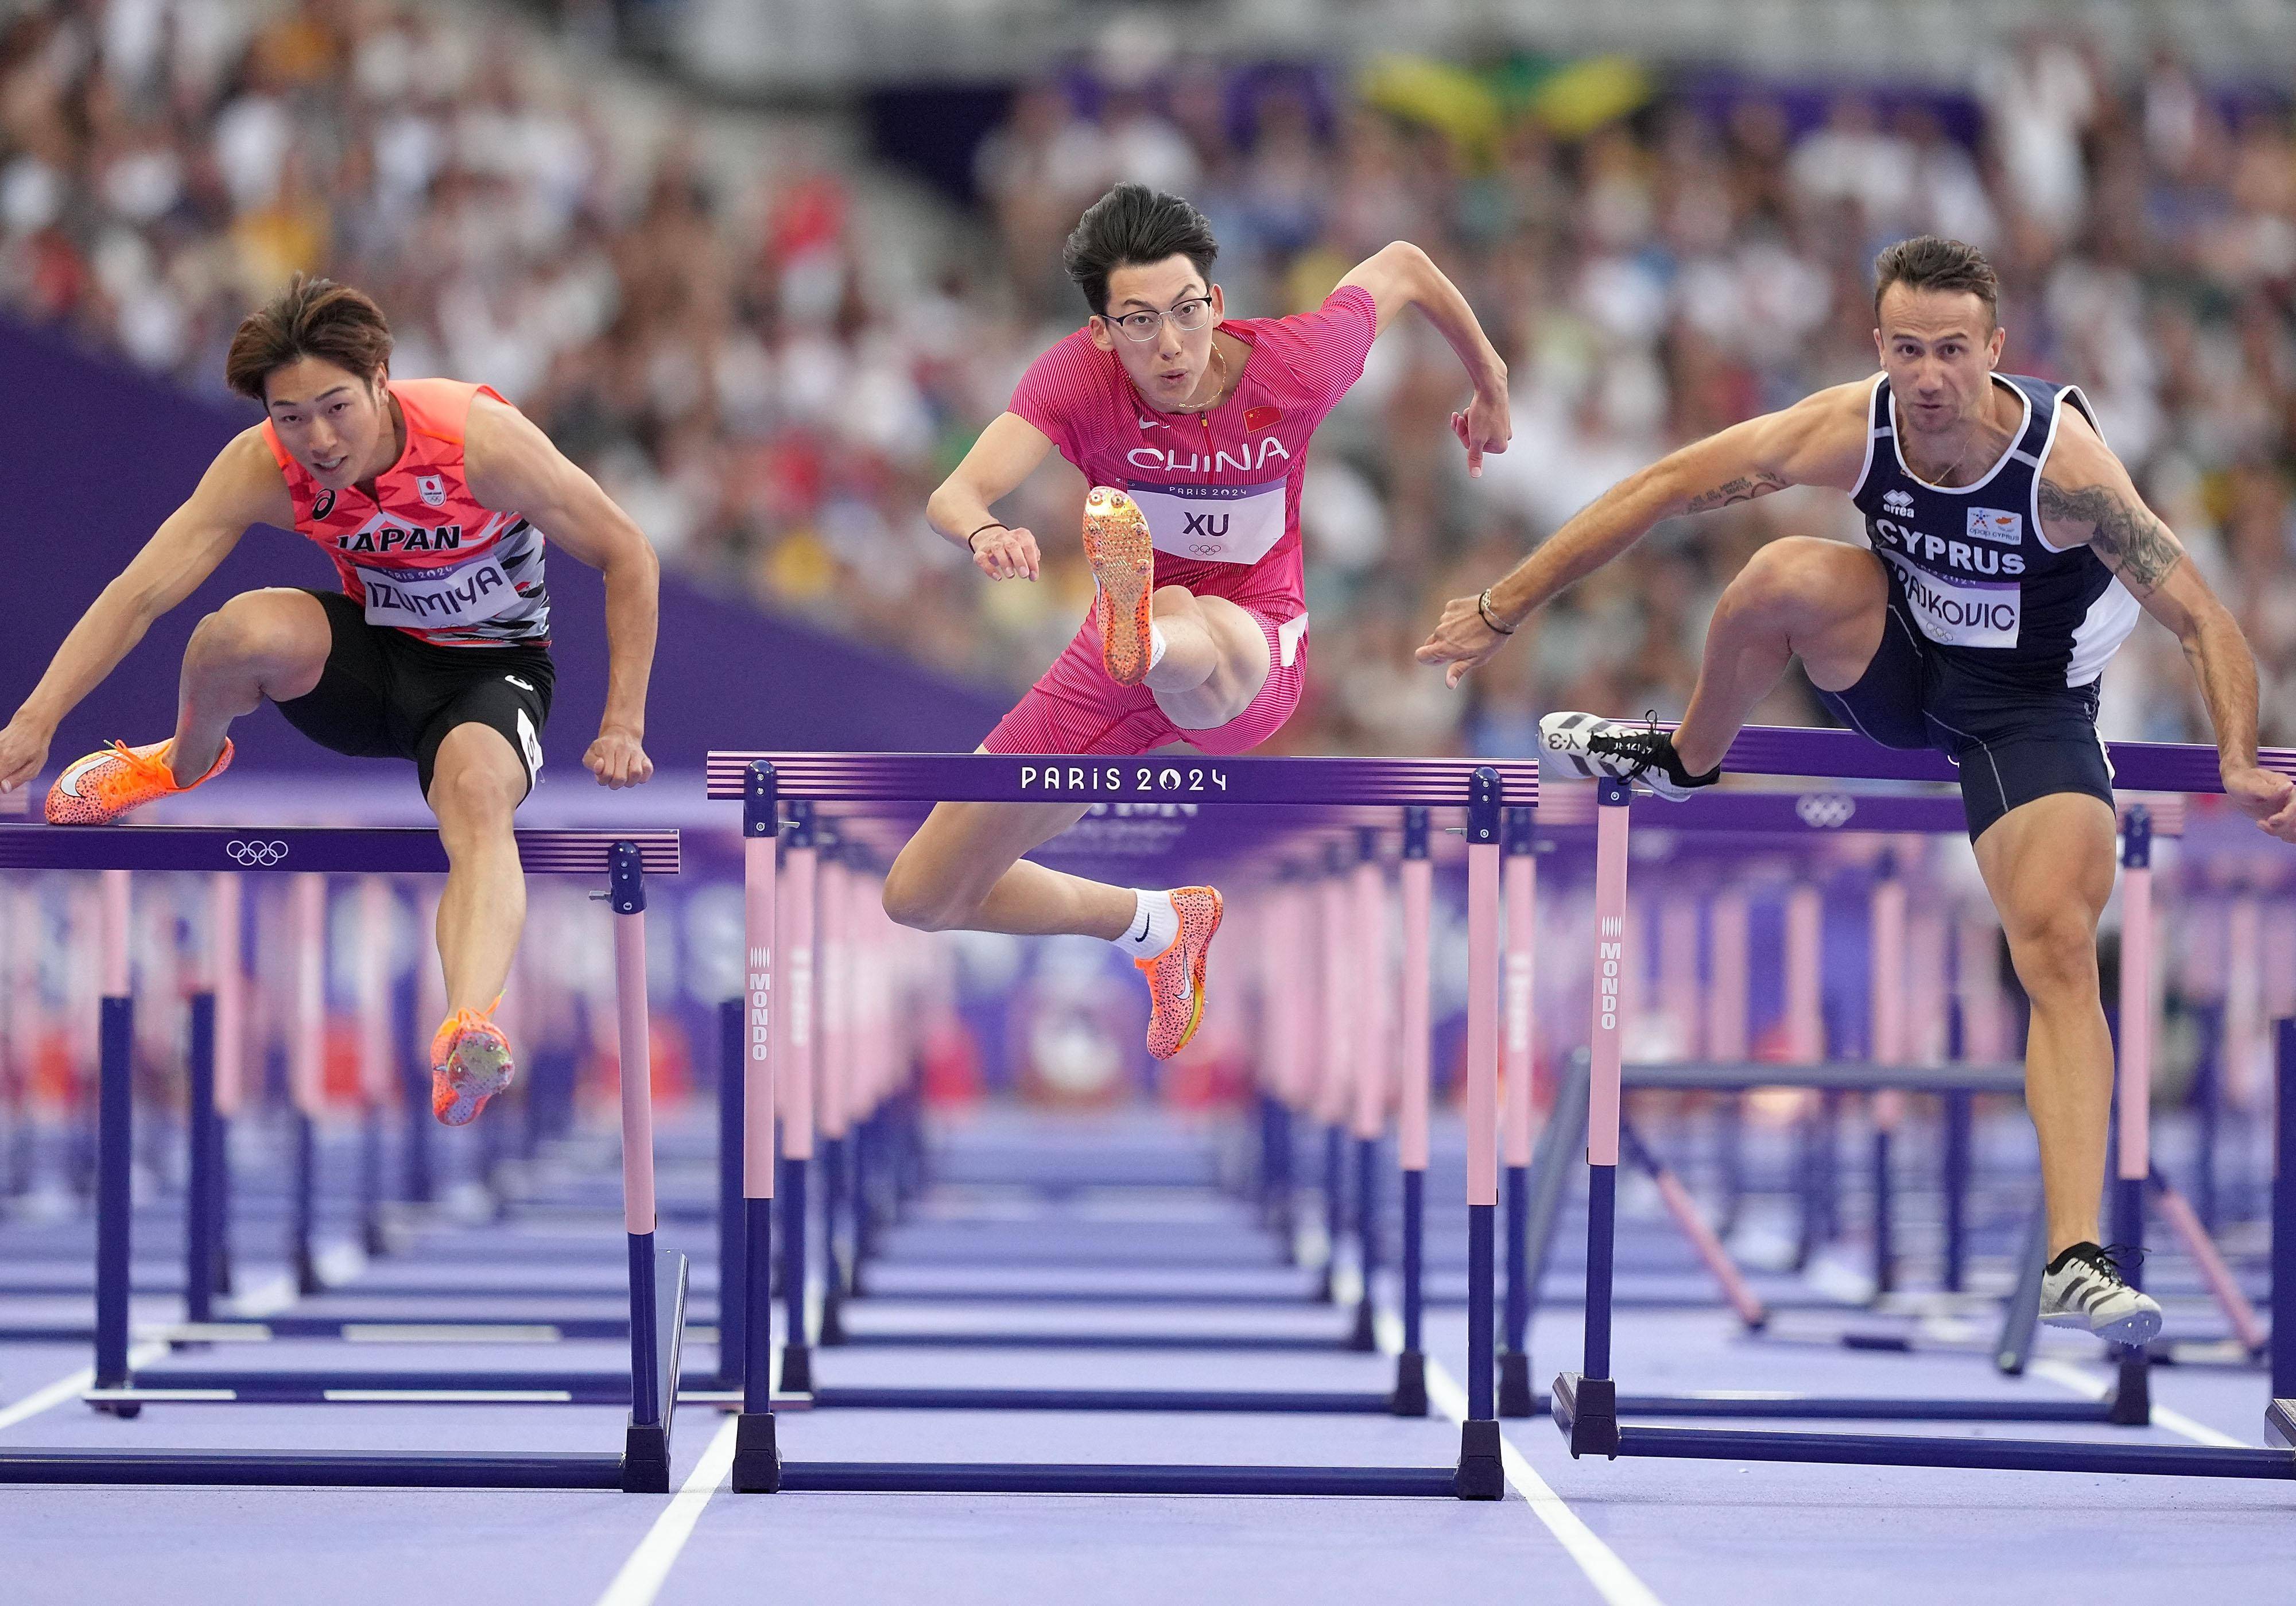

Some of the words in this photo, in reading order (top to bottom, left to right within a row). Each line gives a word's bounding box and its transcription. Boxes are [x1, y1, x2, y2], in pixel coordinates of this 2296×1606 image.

[1127, 436, 1290, 472] CHINA
[1169, 487, 1207, 496] PARIS
[338, 525, 461, 552] JAPAN
[1182, 511, 1230, 537] XU
[1876, 518, 2026, 575] CYPRUS
[367, 566, 503, 617] IZUMIYA
[1548, 732, 1581, 751] Y-3
[1021, 767, 1121, 790] PARIS
[1136, 768, 1227, 791] 2024
[1600, 942, 1622, 1030] MONDO
[750, 973, 770, 1061] MONDO
